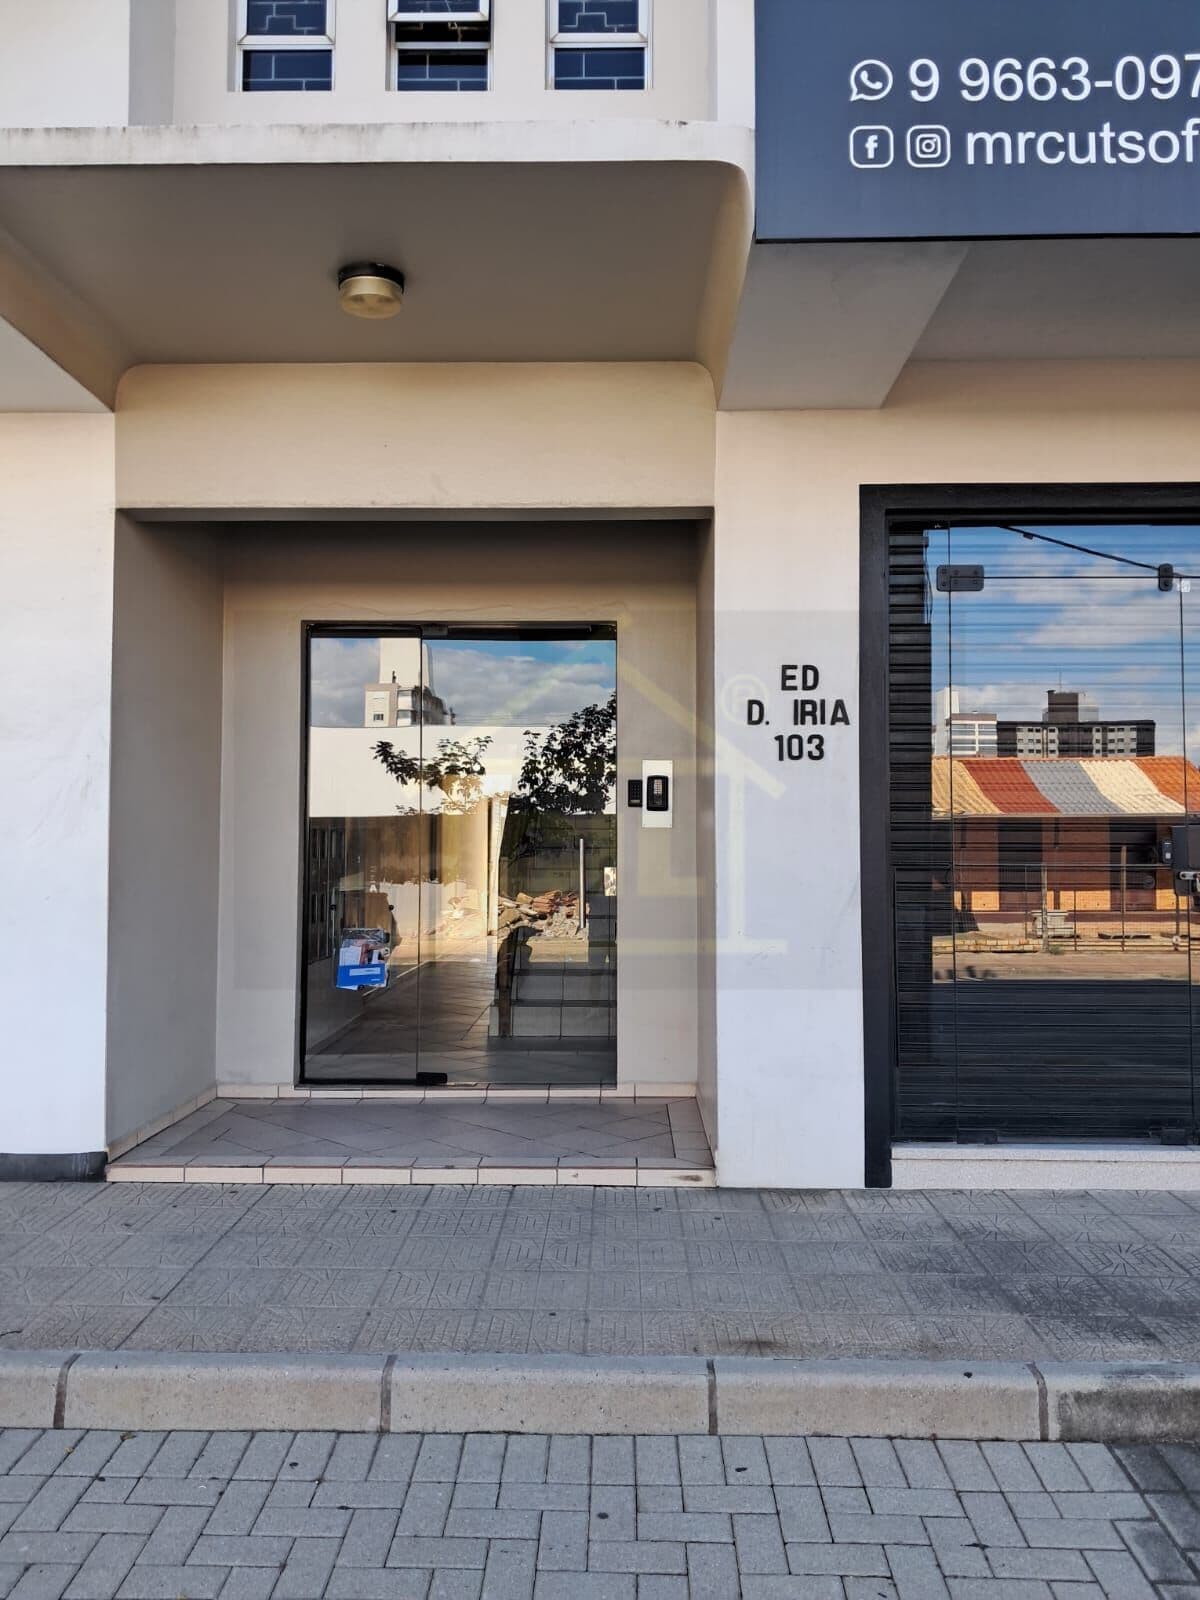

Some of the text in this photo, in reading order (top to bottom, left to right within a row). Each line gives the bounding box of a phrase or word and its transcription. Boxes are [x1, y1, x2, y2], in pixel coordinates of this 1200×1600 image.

[908, 58, 940, 102] 9
[966, 117, 1200, 165] mrcutsof
[780, 664, 820, 692] ED
[747, 698, 851, 726] D. IRIA
[773, 733, 825, 762] 103
